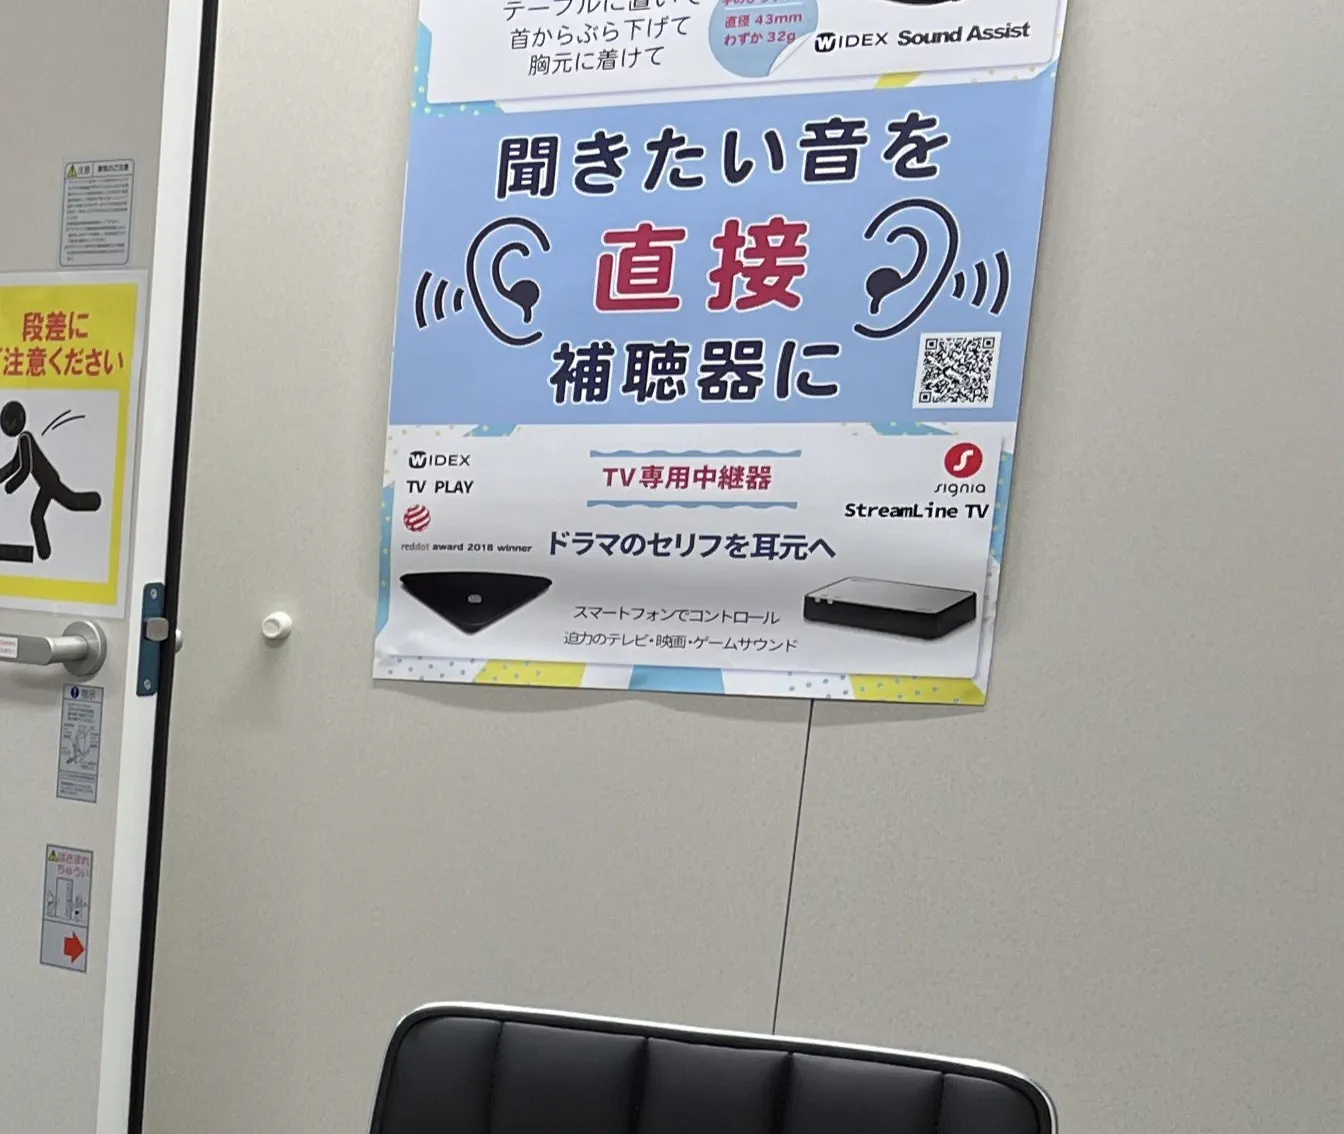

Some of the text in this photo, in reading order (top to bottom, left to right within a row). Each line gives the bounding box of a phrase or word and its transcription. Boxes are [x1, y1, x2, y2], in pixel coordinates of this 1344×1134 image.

[503, 0, 700, 21] テーブルに
[754, 13, 803, 26] 43mm
[511, 16, 692, 50] 首からぶら下げて
[724, 31, 796, 46] わずか 32g
[814, 21, 1031, 53] WIDEX Sound Assist
[528, 46, 664, 76] 胸元に着けて
[496, 112, 950, 199] 聞きたい音を
[595, 217, 810, 312] 直接
[22, 310, 89, 342] 段差に
[550, 340, 842, 403] 補聴器に
[408, 451, 471, 469] WIDEX
[406, 480, 474, 494] TV PLAY
[602, 465, 773, 490] TV専用中継器
[933, 483, 987, 498] signia
[844, 501, 990, 519] StreamLine TV
[432, 543, 464, 552] award
[467, 543, 494, 552] 2018
[497, 544, 532, 553] winner
[550, 531, 837, 561] ドラマのセリフを耳元へ
[573, 605, 780, 625] スマートフォンでコントロール
[563, 630, 799, 653] 迫力のテレビ・映画・ゲームサウンド
